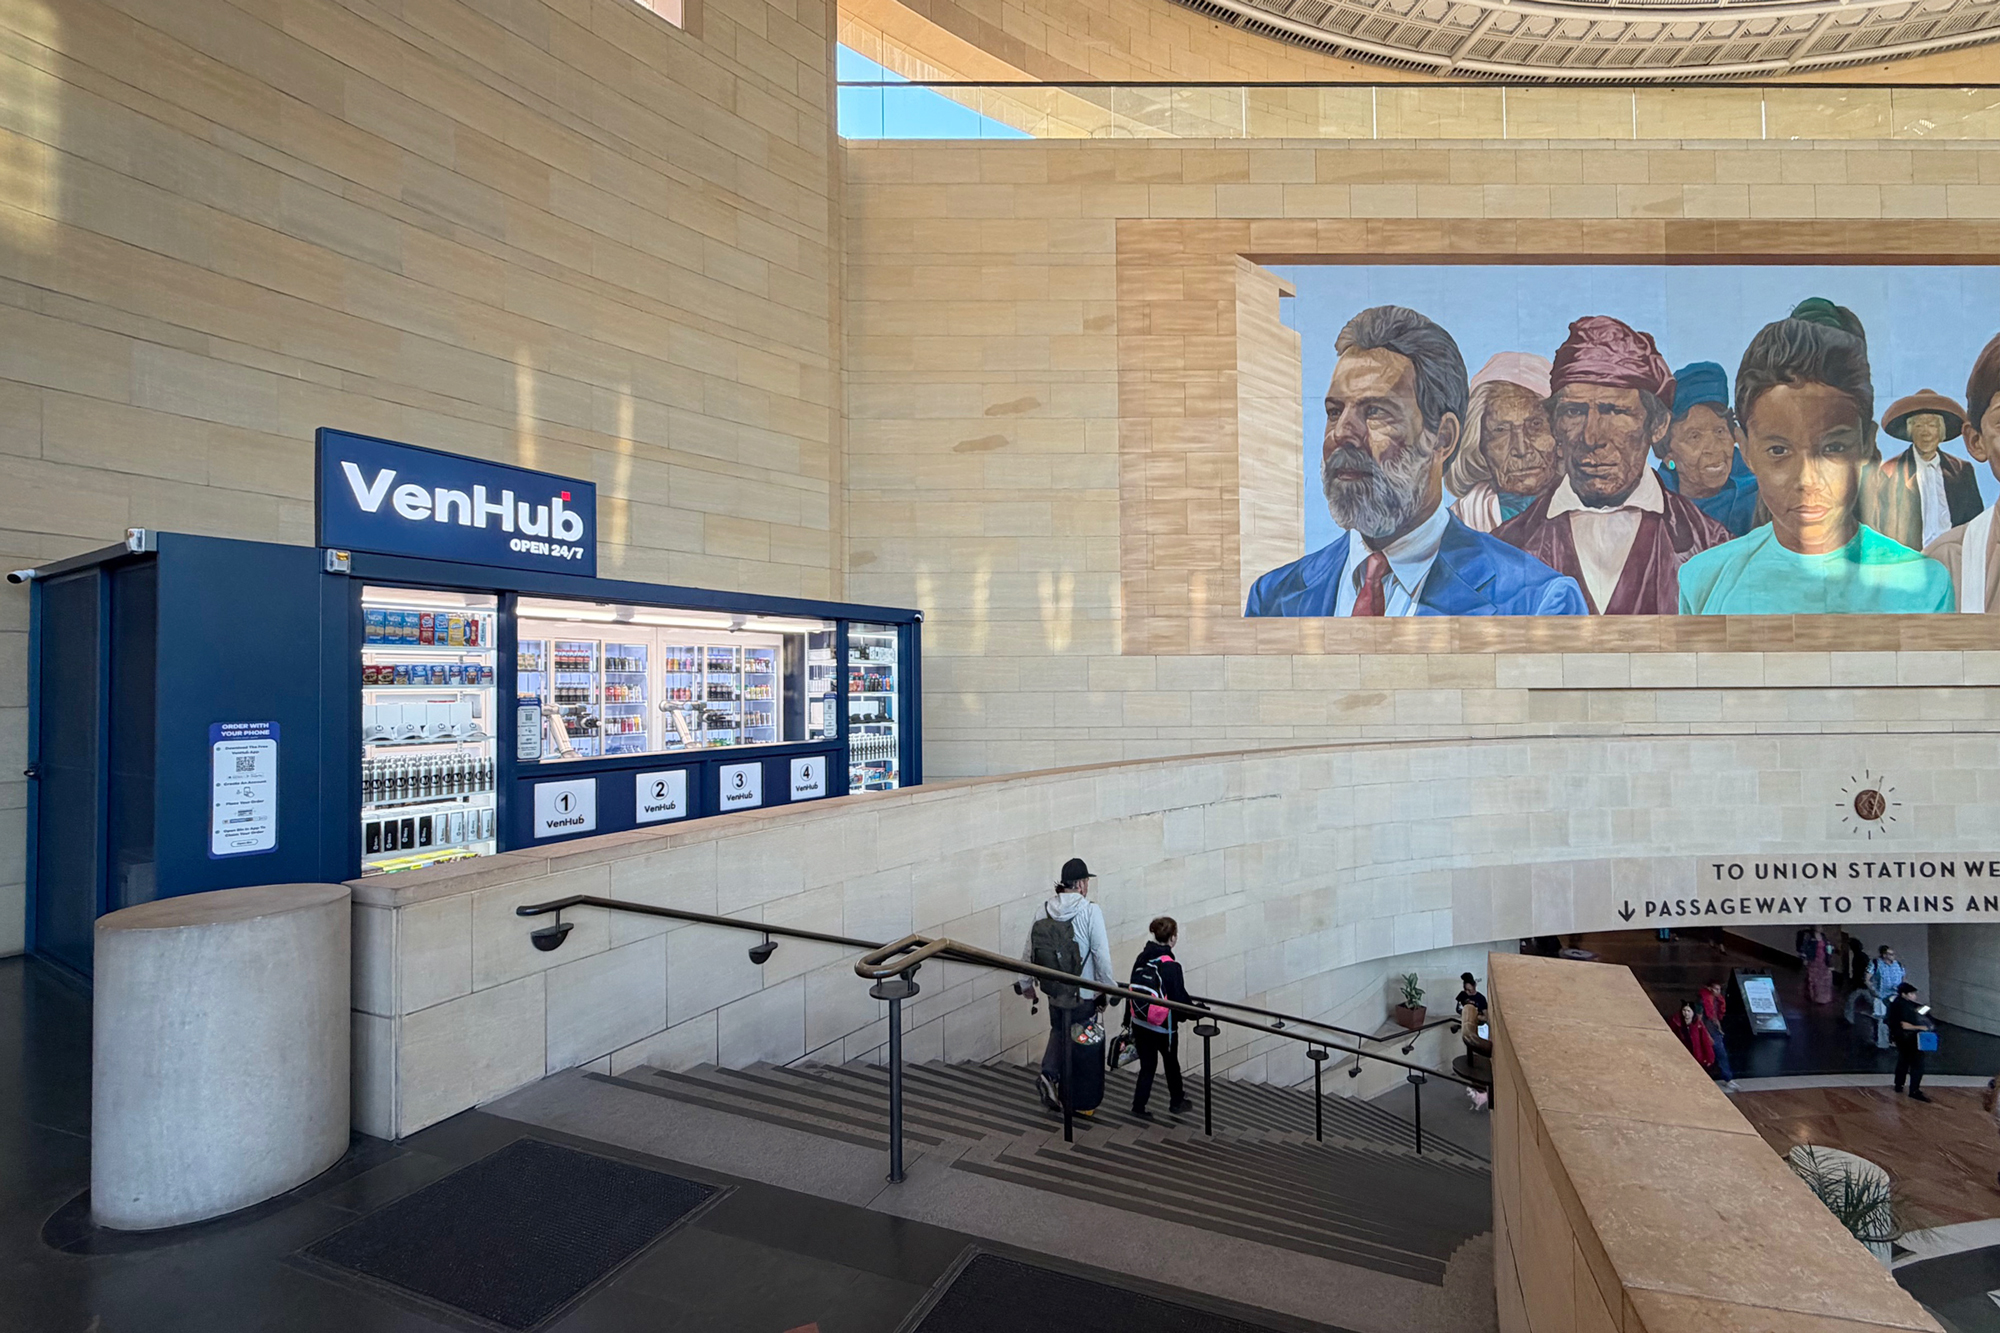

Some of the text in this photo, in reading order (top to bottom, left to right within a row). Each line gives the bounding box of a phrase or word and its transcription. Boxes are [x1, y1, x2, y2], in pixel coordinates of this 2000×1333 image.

[340, 461, 584, 542] VenHub
[509, 538, 584, 560] OPEN 24/7
[802, 765, 810, 779] 4
[735, 773, 744, 788] 3
[795, 781, 818, 792] VenHub
[655, 781, 665, 797] 2
[726, 790, 753, 801] VenHub
[560, 794, 569, 811] 1
[644, 800, 676, 813] VenHub
[546, 814, 585, 829] VenHub
[1712, 860, 2000, 880] TO UNION STATION WE
[1645, 895, 1999, 919] PASSAGEWAY TO TRAINS AN
